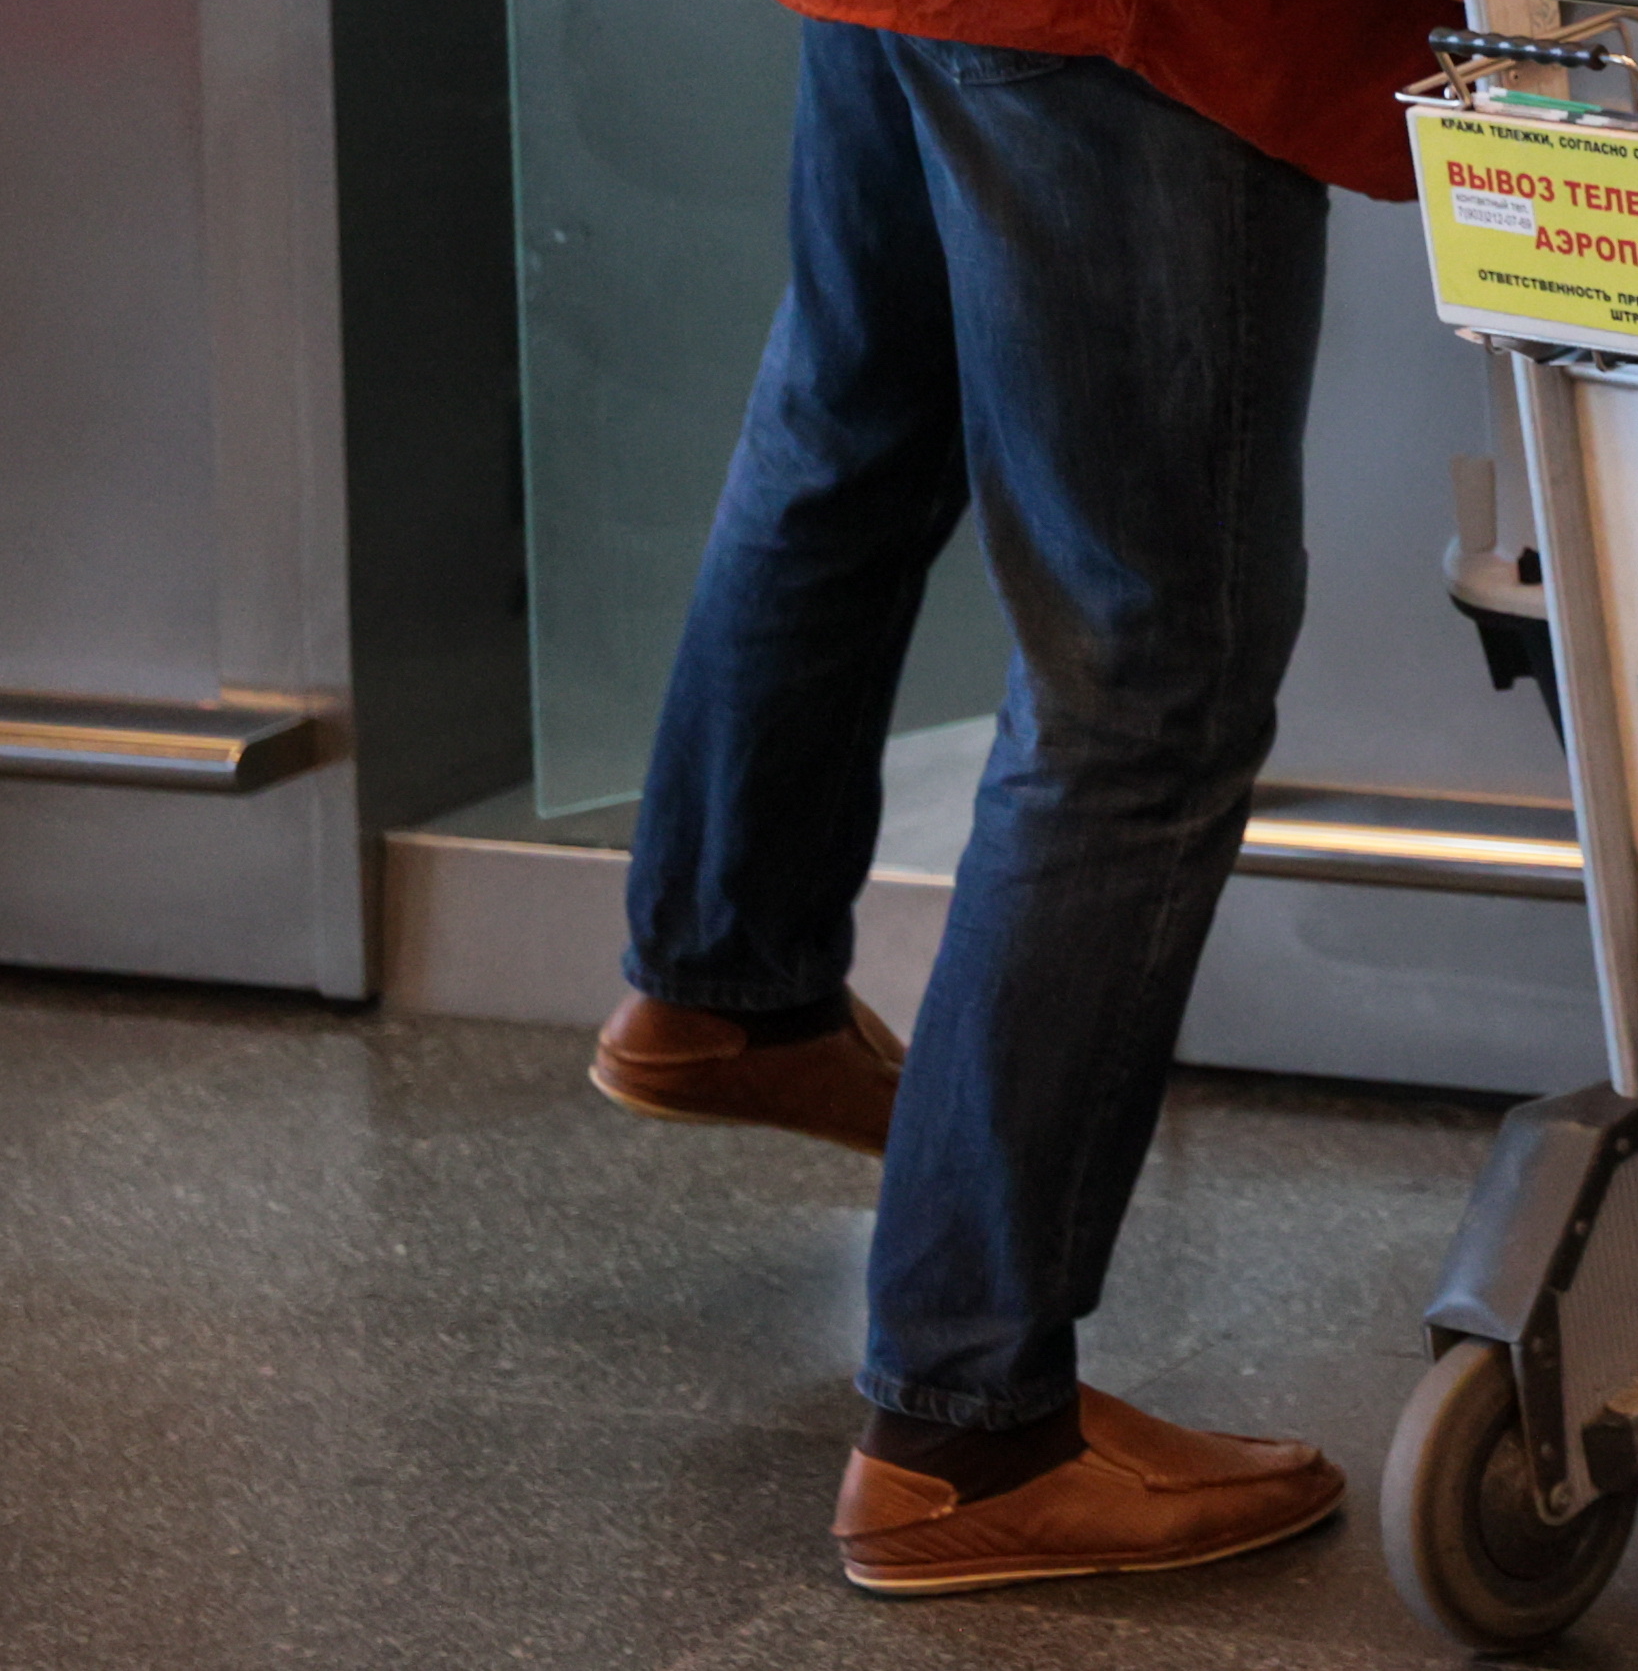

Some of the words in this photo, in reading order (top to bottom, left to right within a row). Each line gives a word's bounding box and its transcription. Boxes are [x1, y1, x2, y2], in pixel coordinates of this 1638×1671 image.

[1441, 118, 1485, 136] КРАЖА
[1490, 125, 1554, 149] ТЕЛЕЖКИ,
[1559, 137, 1628, 159] СОГЛАСНО
[1446, 160, 1556, 203] ВЫВОЗ
[1478, 268, 1612, 302] ОТВЕТСТВЕННОСТЬ
